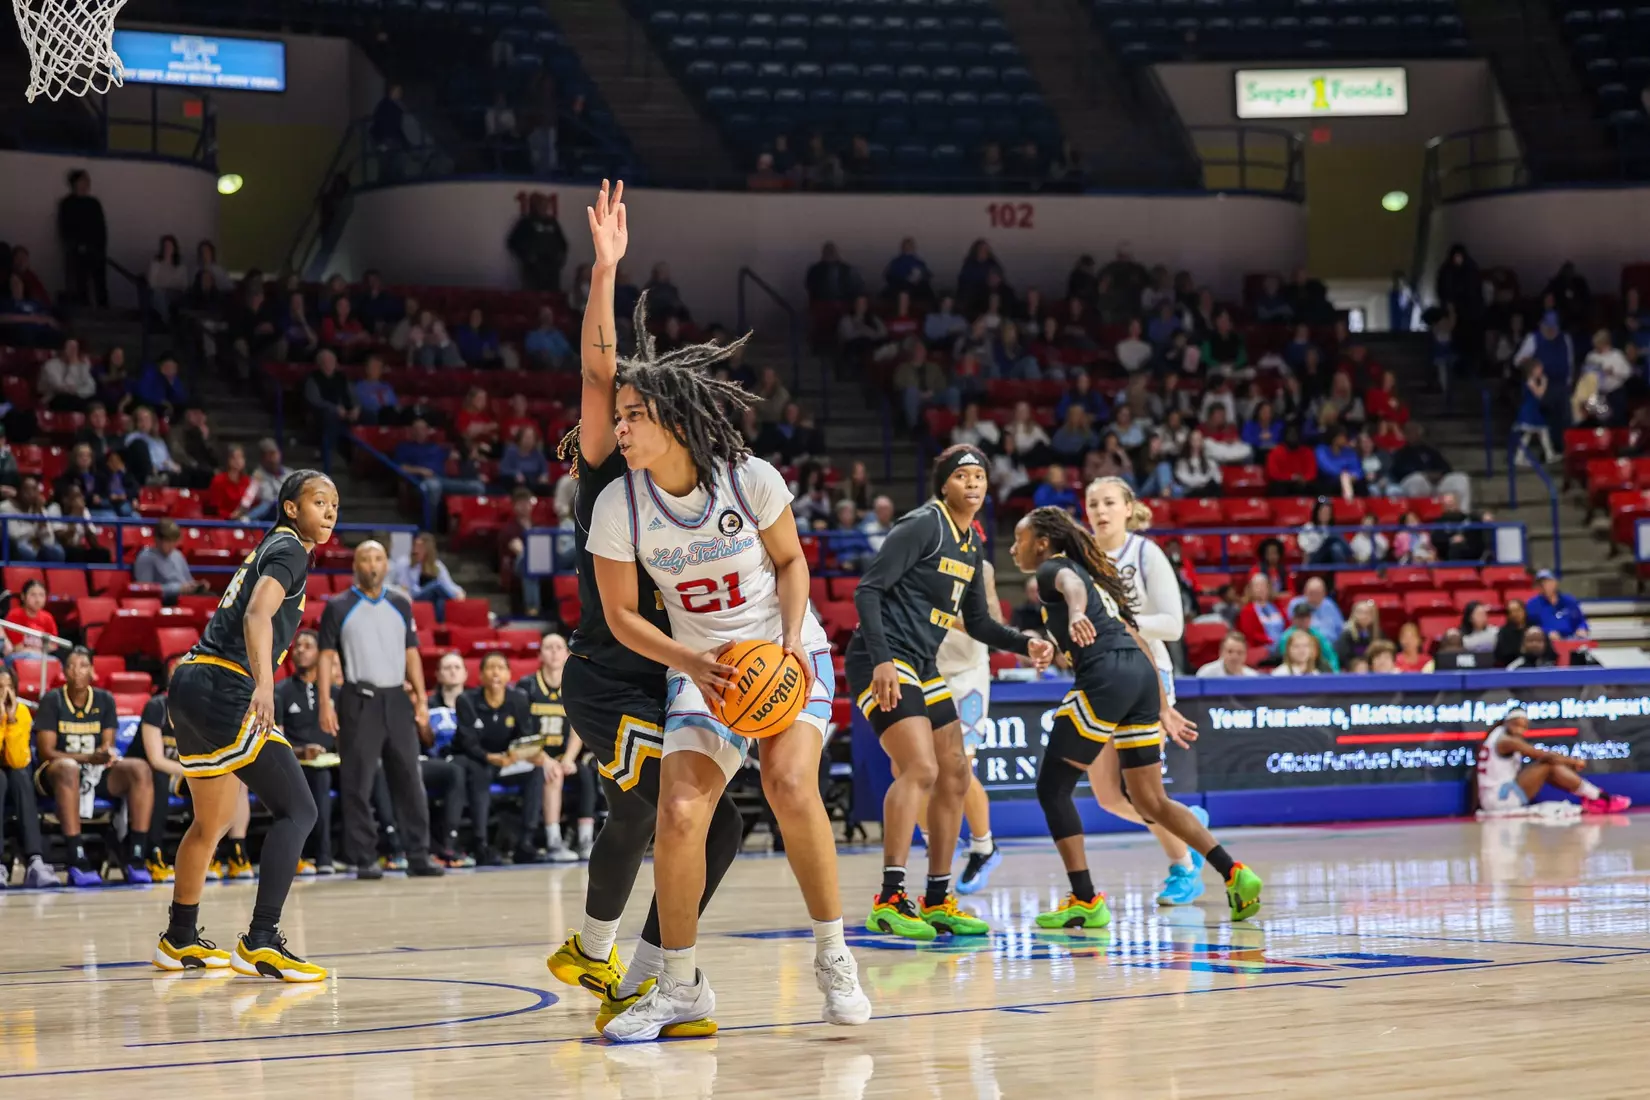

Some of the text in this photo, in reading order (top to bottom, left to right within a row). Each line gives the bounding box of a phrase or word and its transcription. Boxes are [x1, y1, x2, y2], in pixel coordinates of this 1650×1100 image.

[1247, 76, 1394, 110] Super 1 Foods
[987, 203, 1034, 229] 102
[646, 536, 754, 575] Lady Techsters
[675, 571, 747, 613] 21
[737, 656, 766, 695] EVO
[750, 666, 799, 722] Wilson
[1209, 707, 1254, 729] Your
[1256, 705, 1350, 730] Furniture,
[1350, 703, 1435, 726] Mattress
[1436, 700, 1473, 723] and
